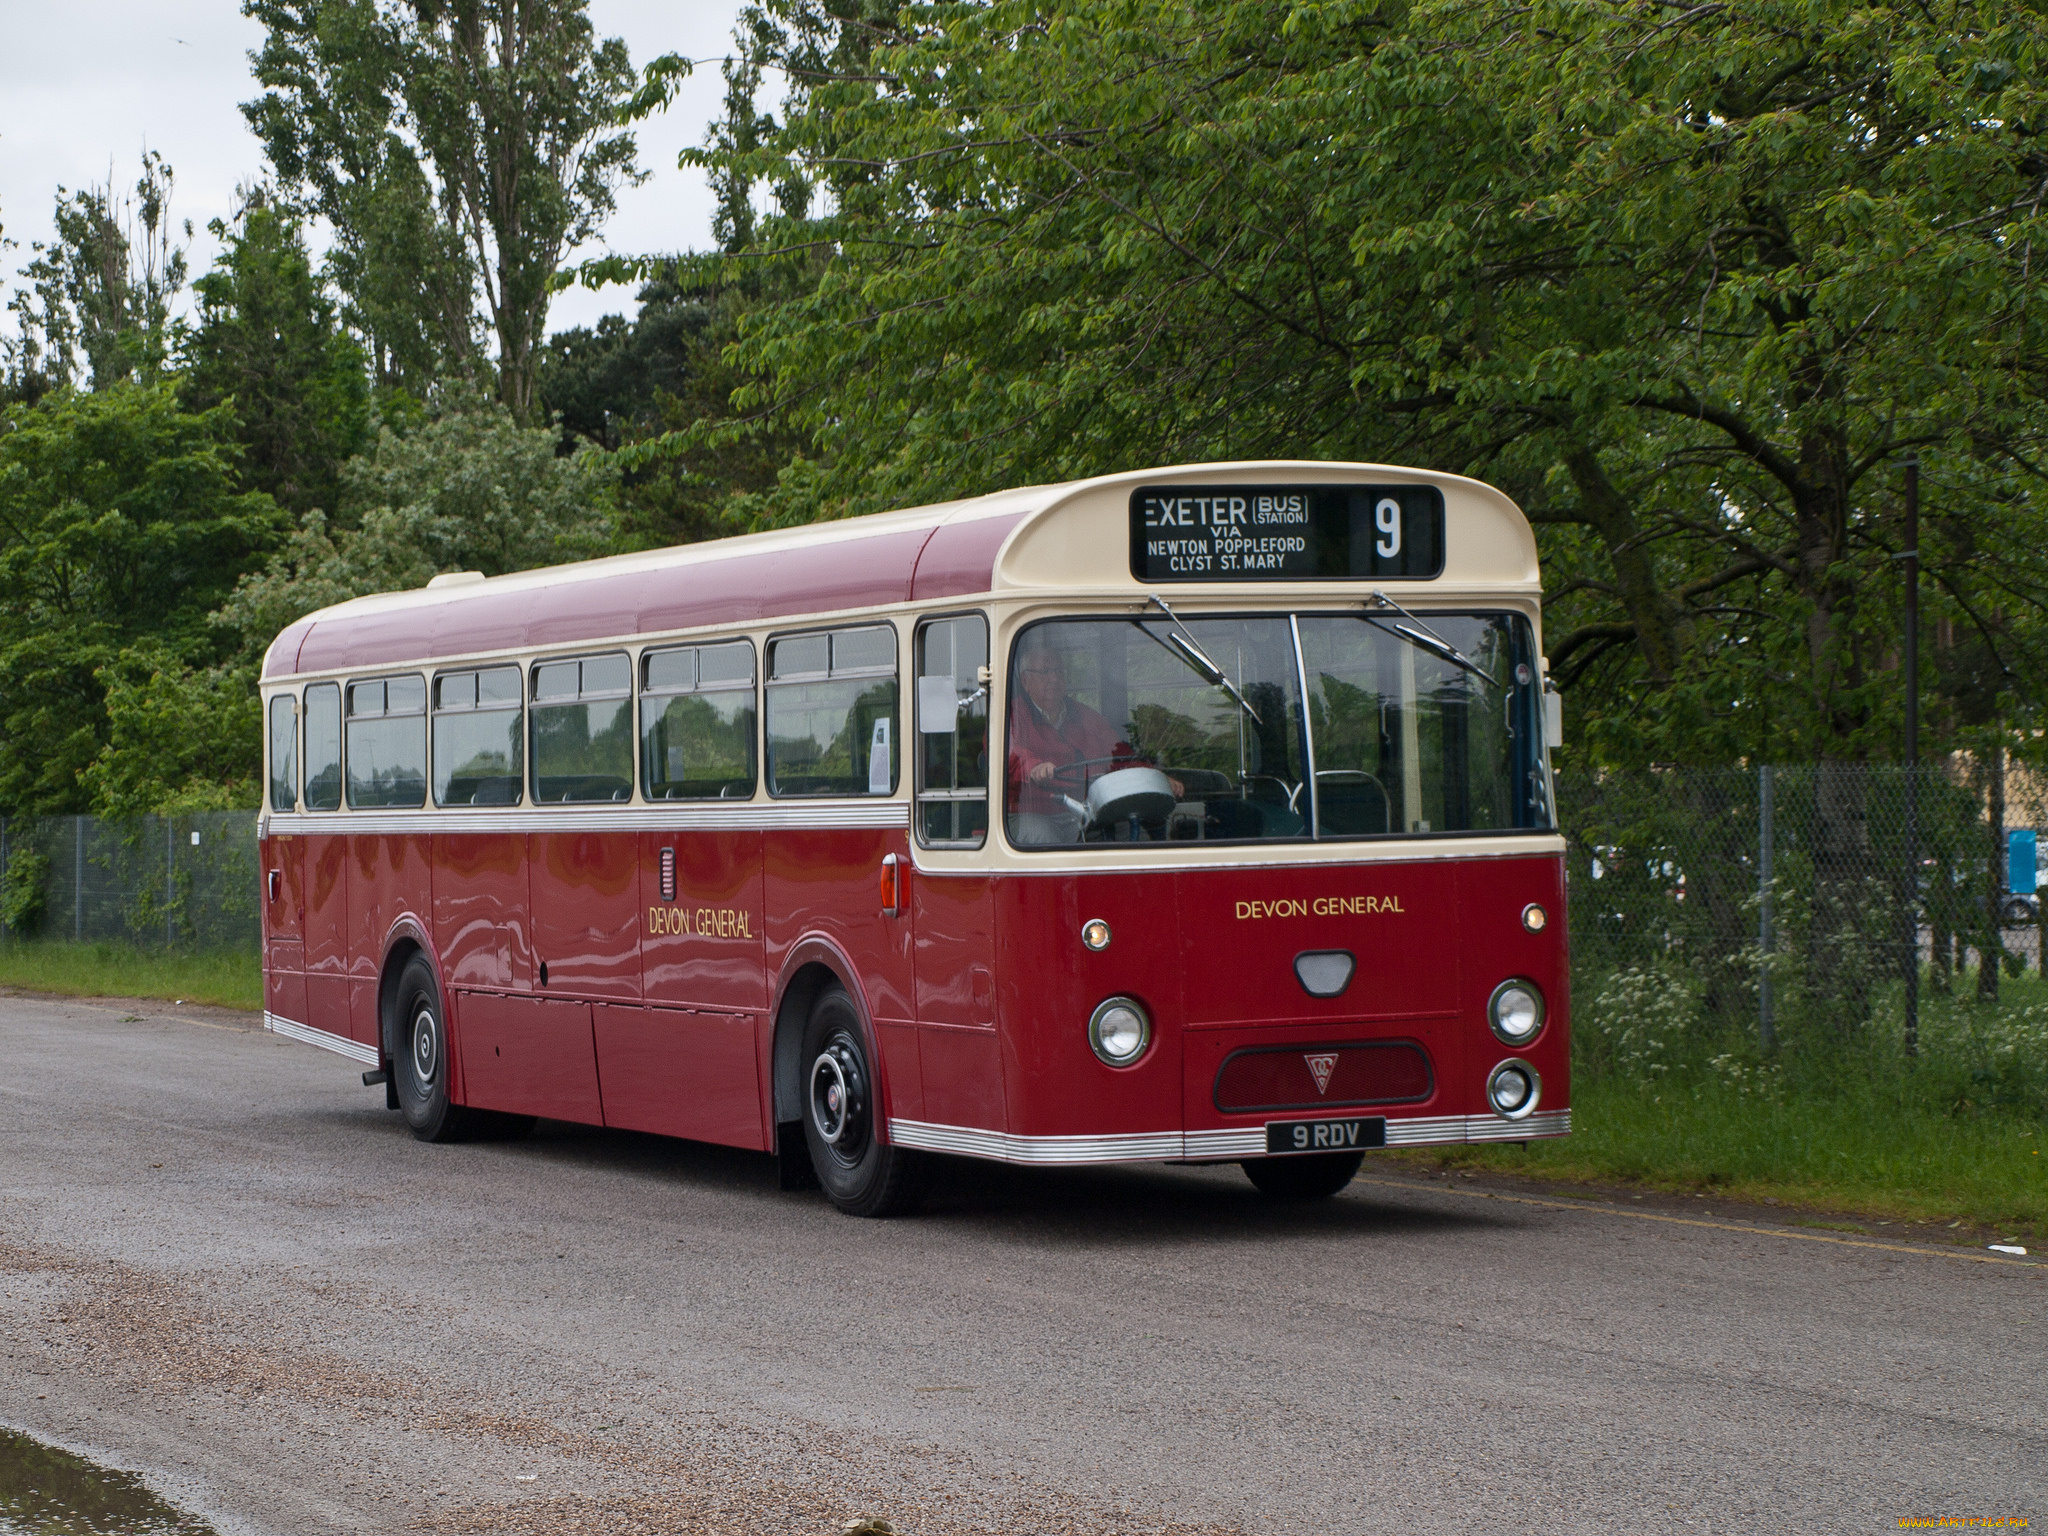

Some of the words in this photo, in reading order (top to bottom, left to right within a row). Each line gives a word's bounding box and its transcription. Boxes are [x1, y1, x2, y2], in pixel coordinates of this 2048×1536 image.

[1145, 498, 1247, 526] EXETER
[1210, 526, 1242, 537] VIA
[1375, 498, 1401, 558] 9
[1148, 540, 1208, 555] NEWTON
[1215, 538, 1305, 553] POPPLEFORD
[1170, 556, 1212, 571] CLYST
[1236, 900, 1307, 920] DEVON
[1313, 897, 1404, 915] GENERAL
[649, 907, 690, 935] DEVON
[695, 908, 752, 938] GENERAL
[1293, 1126, 1308, 1148] 9
[1314, 1122, 1360, 1146] RDV
